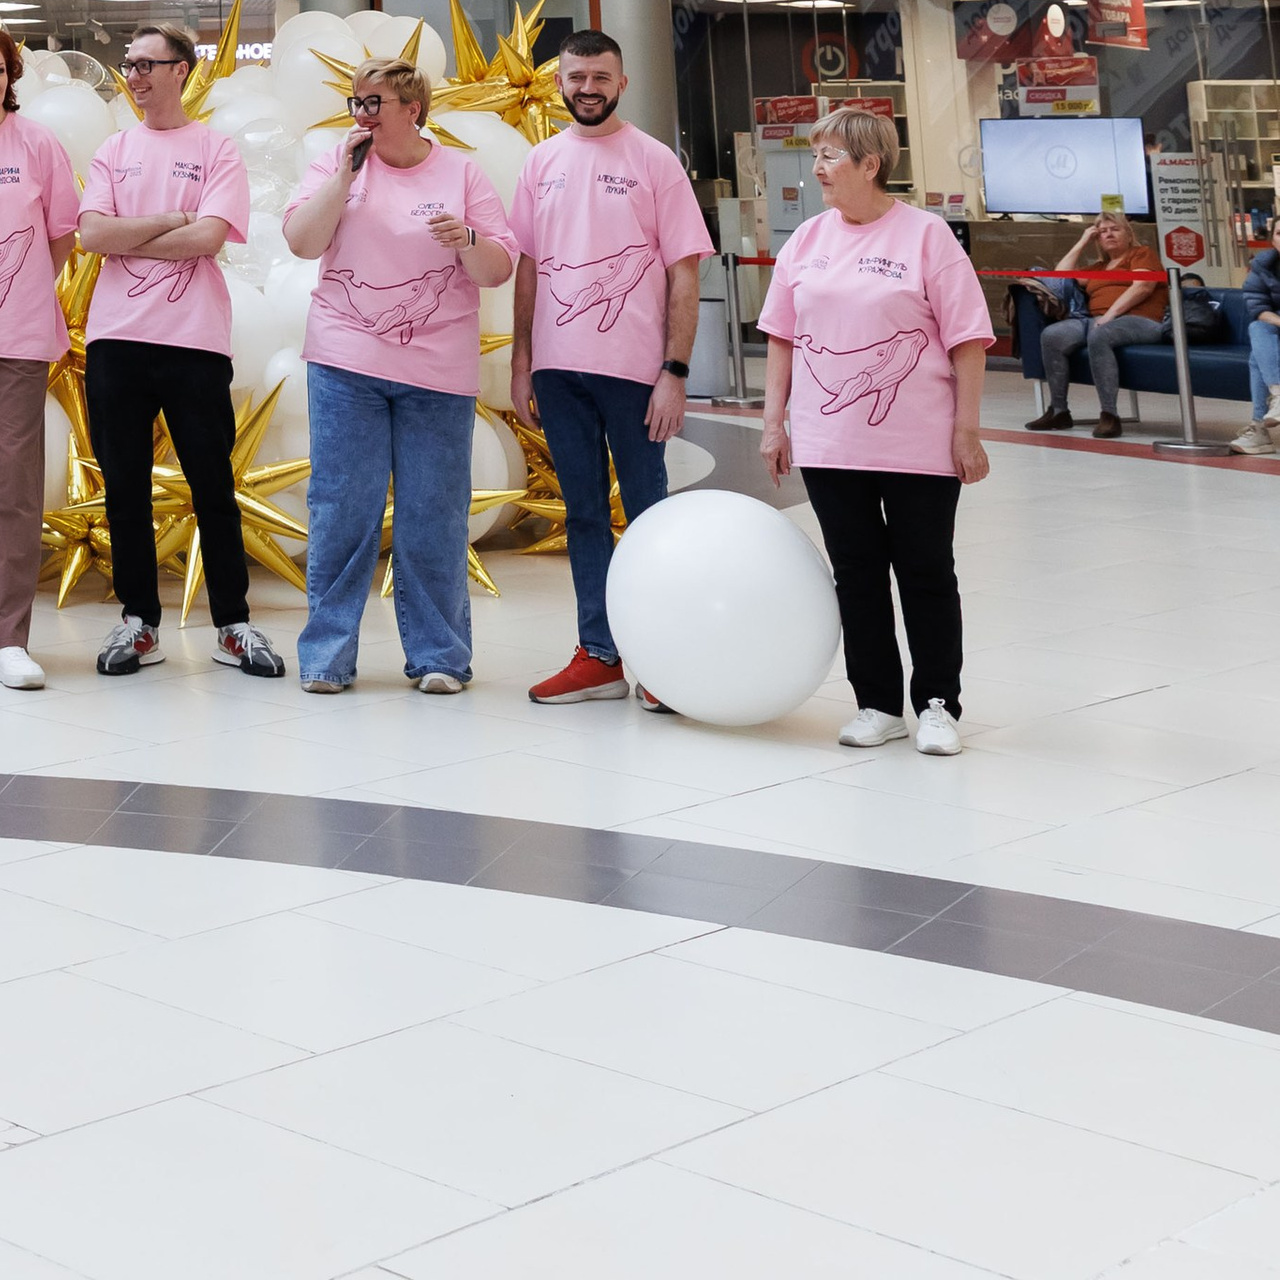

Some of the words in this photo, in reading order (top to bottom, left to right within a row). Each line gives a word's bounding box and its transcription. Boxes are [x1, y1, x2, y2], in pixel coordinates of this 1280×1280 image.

[1029, 91, 1063, 100] СКИДКА
[764, 129, 791, 137] СКИДКА
[174, 161, 202, 173] МАКСИМ
[172, 170, 201, 183] КУЗЬМИН
[597, 174, 638, 189] АЛЕКСАНДР
[1170, 186, 1180, 194] 15
[417, 202, 444, 211] ОЛЕСЯ
[1161, 205, 1173, 214] 90
